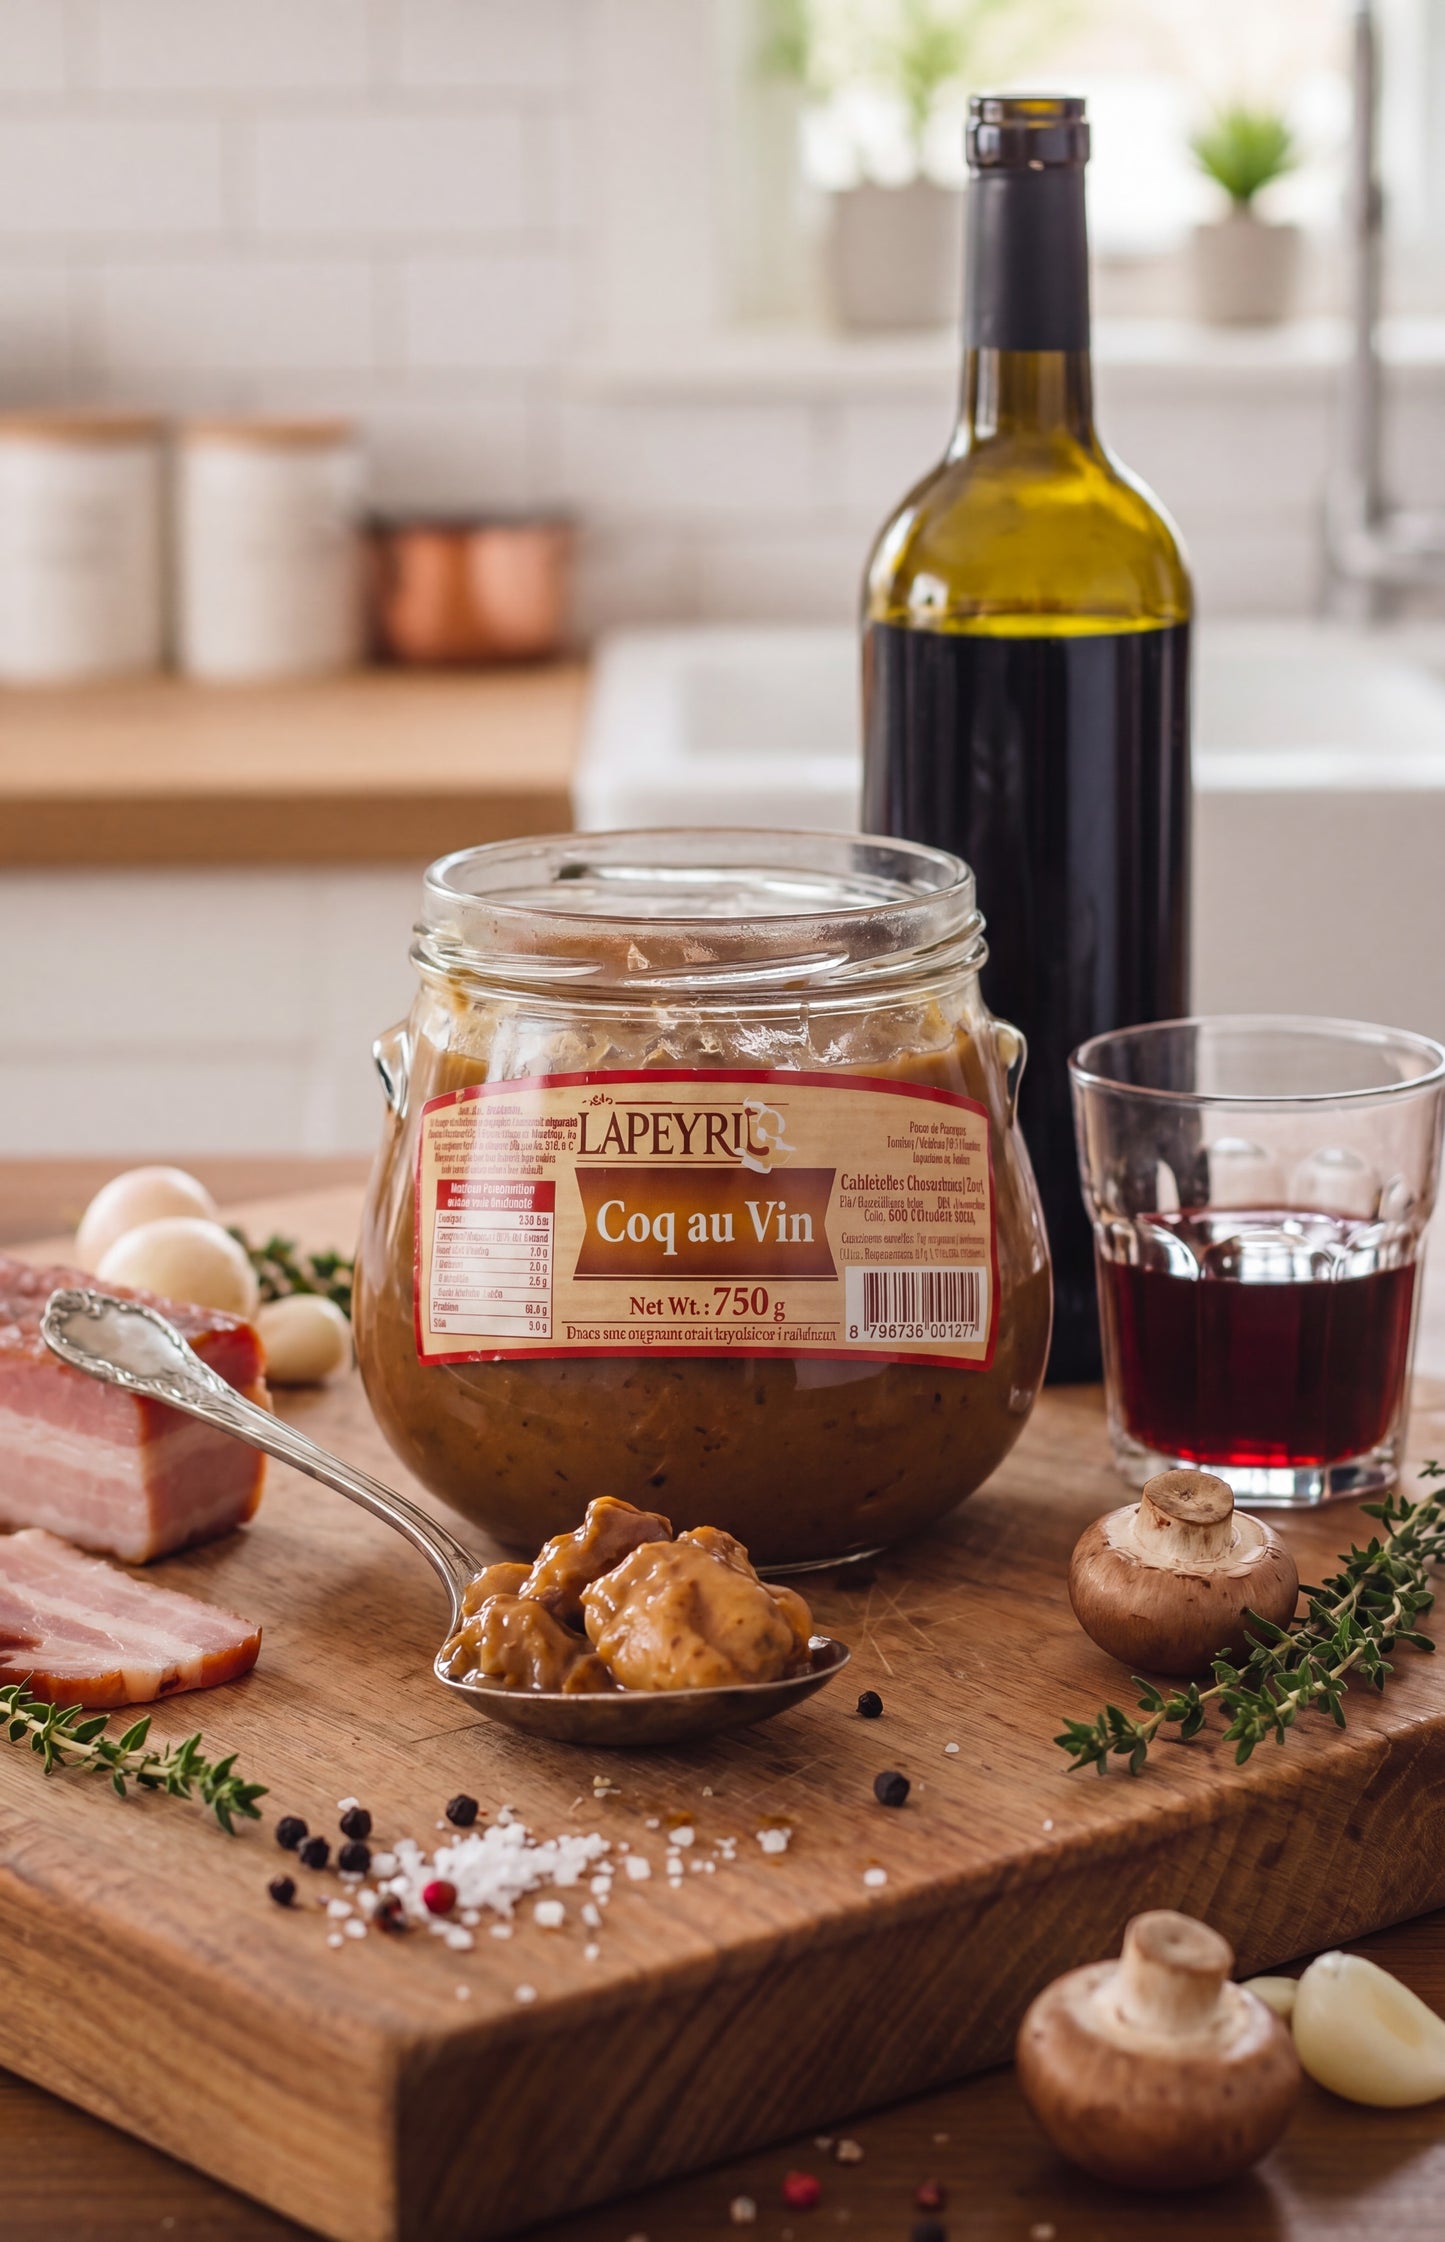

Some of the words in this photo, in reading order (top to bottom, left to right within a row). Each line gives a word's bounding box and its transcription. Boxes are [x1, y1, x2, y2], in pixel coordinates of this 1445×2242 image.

[596, 1200, 678, 1255] Coq
[687, 1212, 735, 1242] au
[744, 1200, 815, 1242] Vin
[629, 1296, 663, 1316] Net
[713, 1286, 769, 1316] 750
[773, 1300, 786, 1321] g
[849, 1325, 859, 1339] 8
[869, 1324, 924, 1339] 796736
[930, 1323, 976, 1339] 001277
